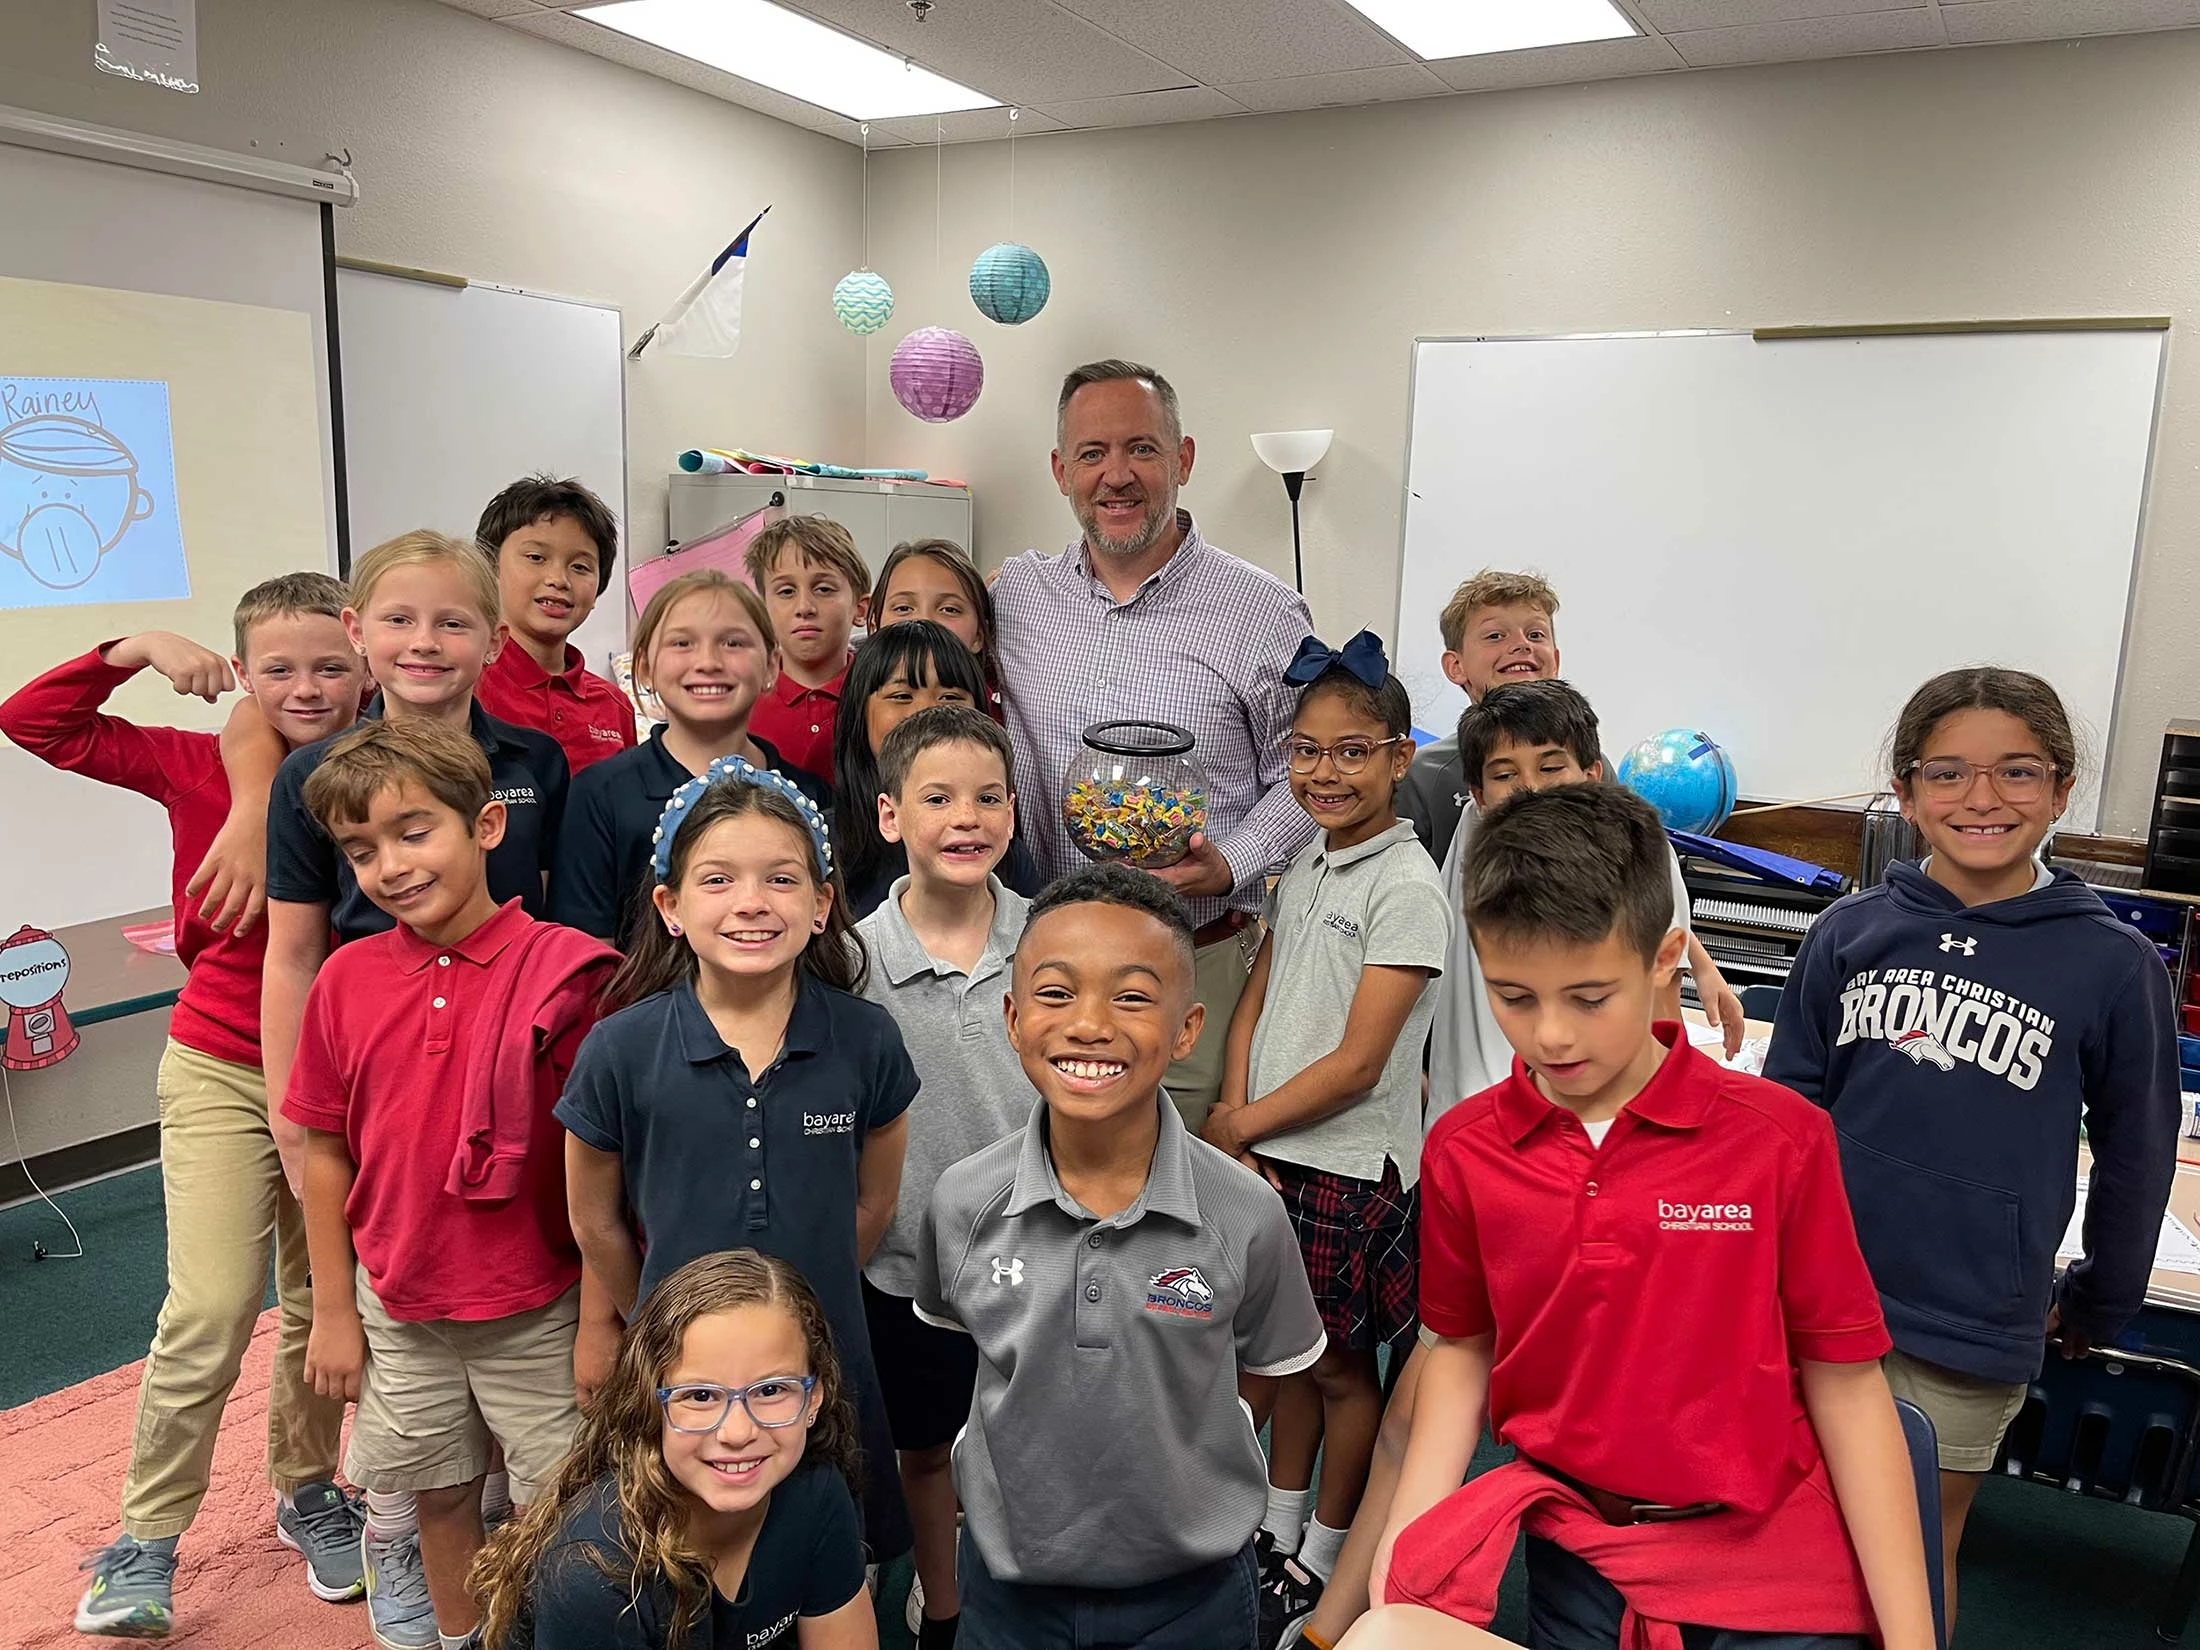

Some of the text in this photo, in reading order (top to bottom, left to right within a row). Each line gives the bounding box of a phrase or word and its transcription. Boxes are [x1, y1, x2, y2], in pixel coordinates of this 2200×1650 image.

[1, 384, 104, 429] Rainey
[0, 958, 67, 983] repositions
[1845, 968, 2056, 1036] BAY AREA CHRISTIAN
[1835, 983, 2053, 1091] BRONCOS
[1657, 1198, 1752, 1223] bayarea
[1712, 1221, 1755, 1231] SCHOOL
[1147, 1294, 1213, 1312] BRONCOS
